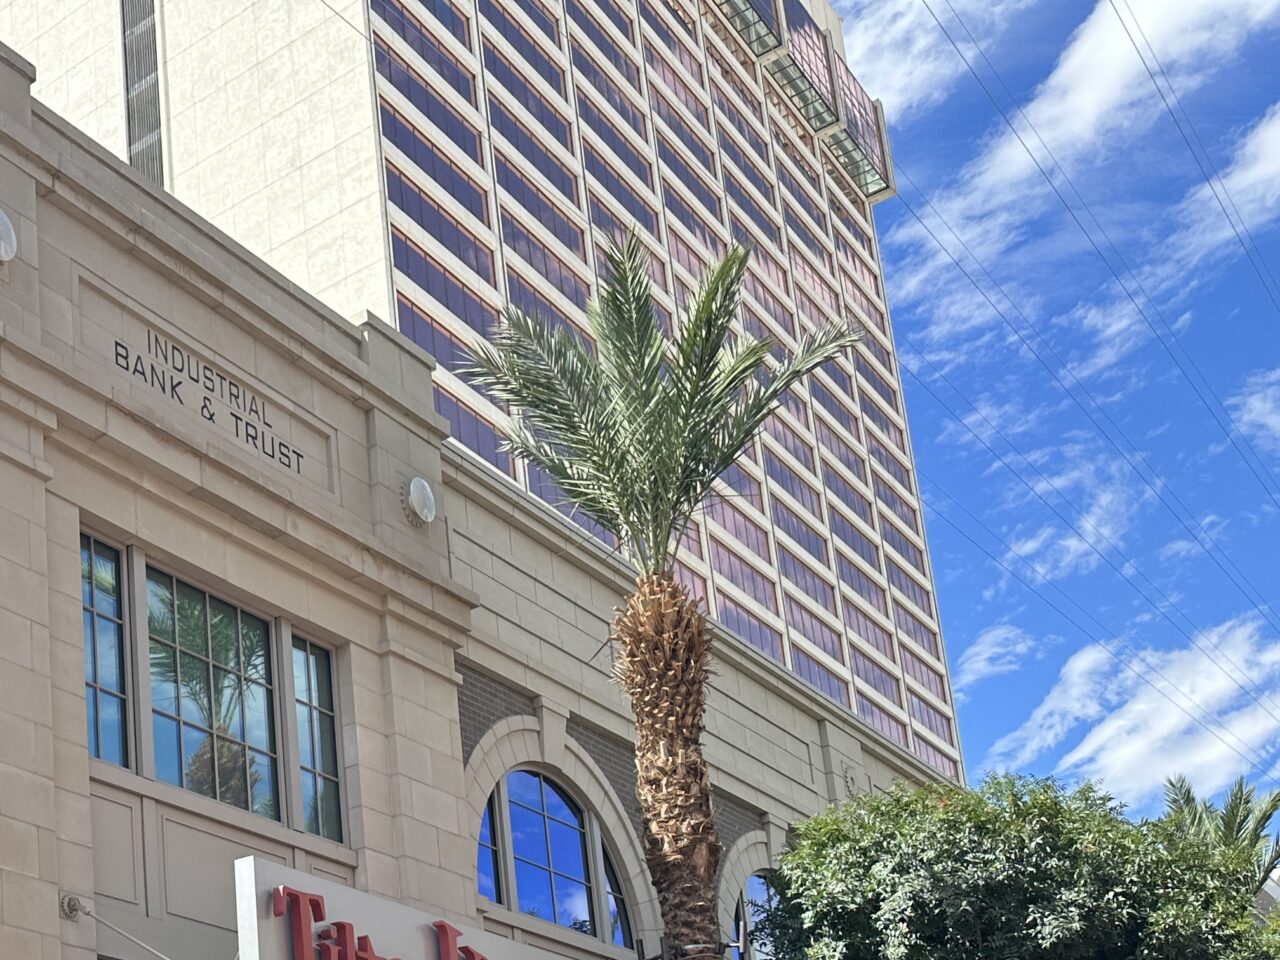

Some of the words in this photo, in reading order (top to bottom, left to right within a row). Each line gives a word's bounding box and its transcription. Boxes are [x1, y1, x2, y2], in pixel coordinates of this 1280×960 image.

[114, 340, 184, 405] BANK
[200, 396, 216, 424] &
[230, 412, 304, 474] TRUST
[147, 329, 272, 429] INDUSTRIAL
